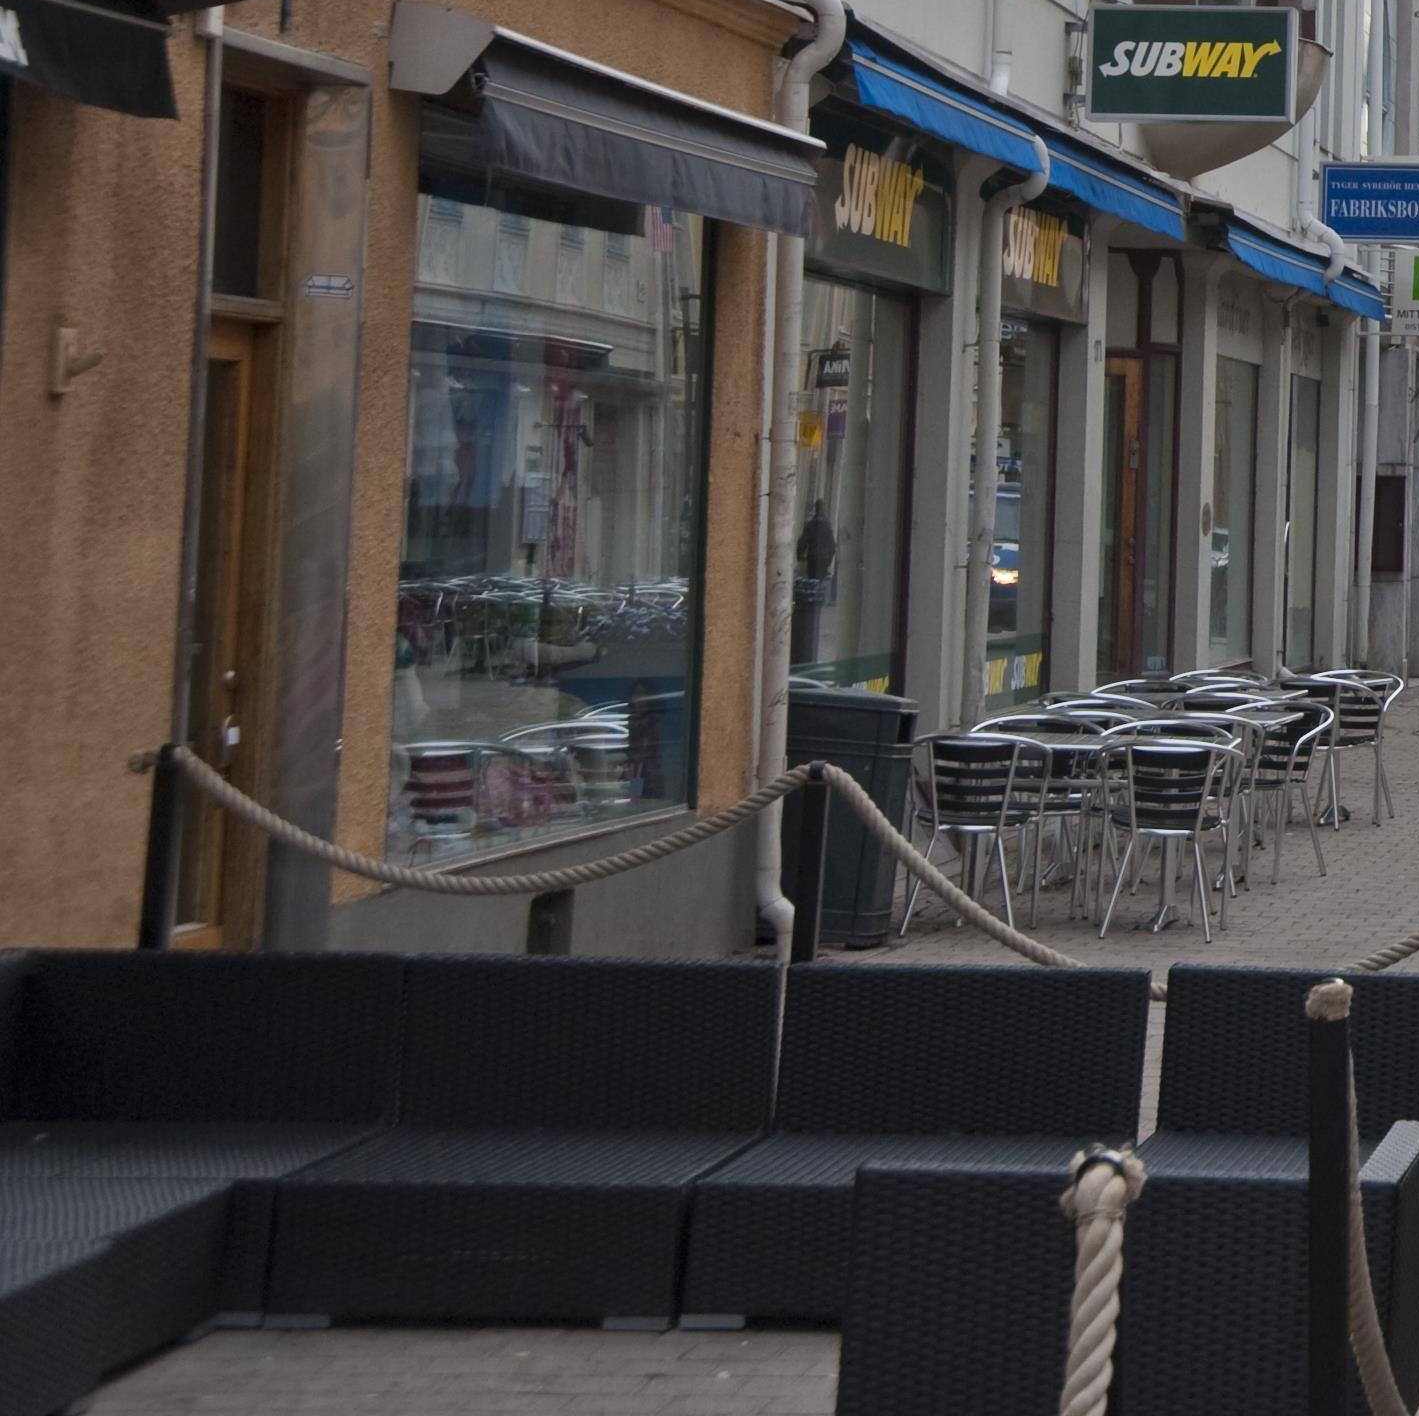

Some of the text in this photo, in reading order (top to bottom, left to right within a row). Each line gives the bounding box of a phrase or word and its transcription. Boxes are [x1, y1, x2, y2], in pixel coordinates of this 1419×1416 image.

[1098, 39, 1282, 79] SUBWAY
[834, 142, 925, 248] SUBWAY
[1003, 205, 1069, 287] SUBWAY
